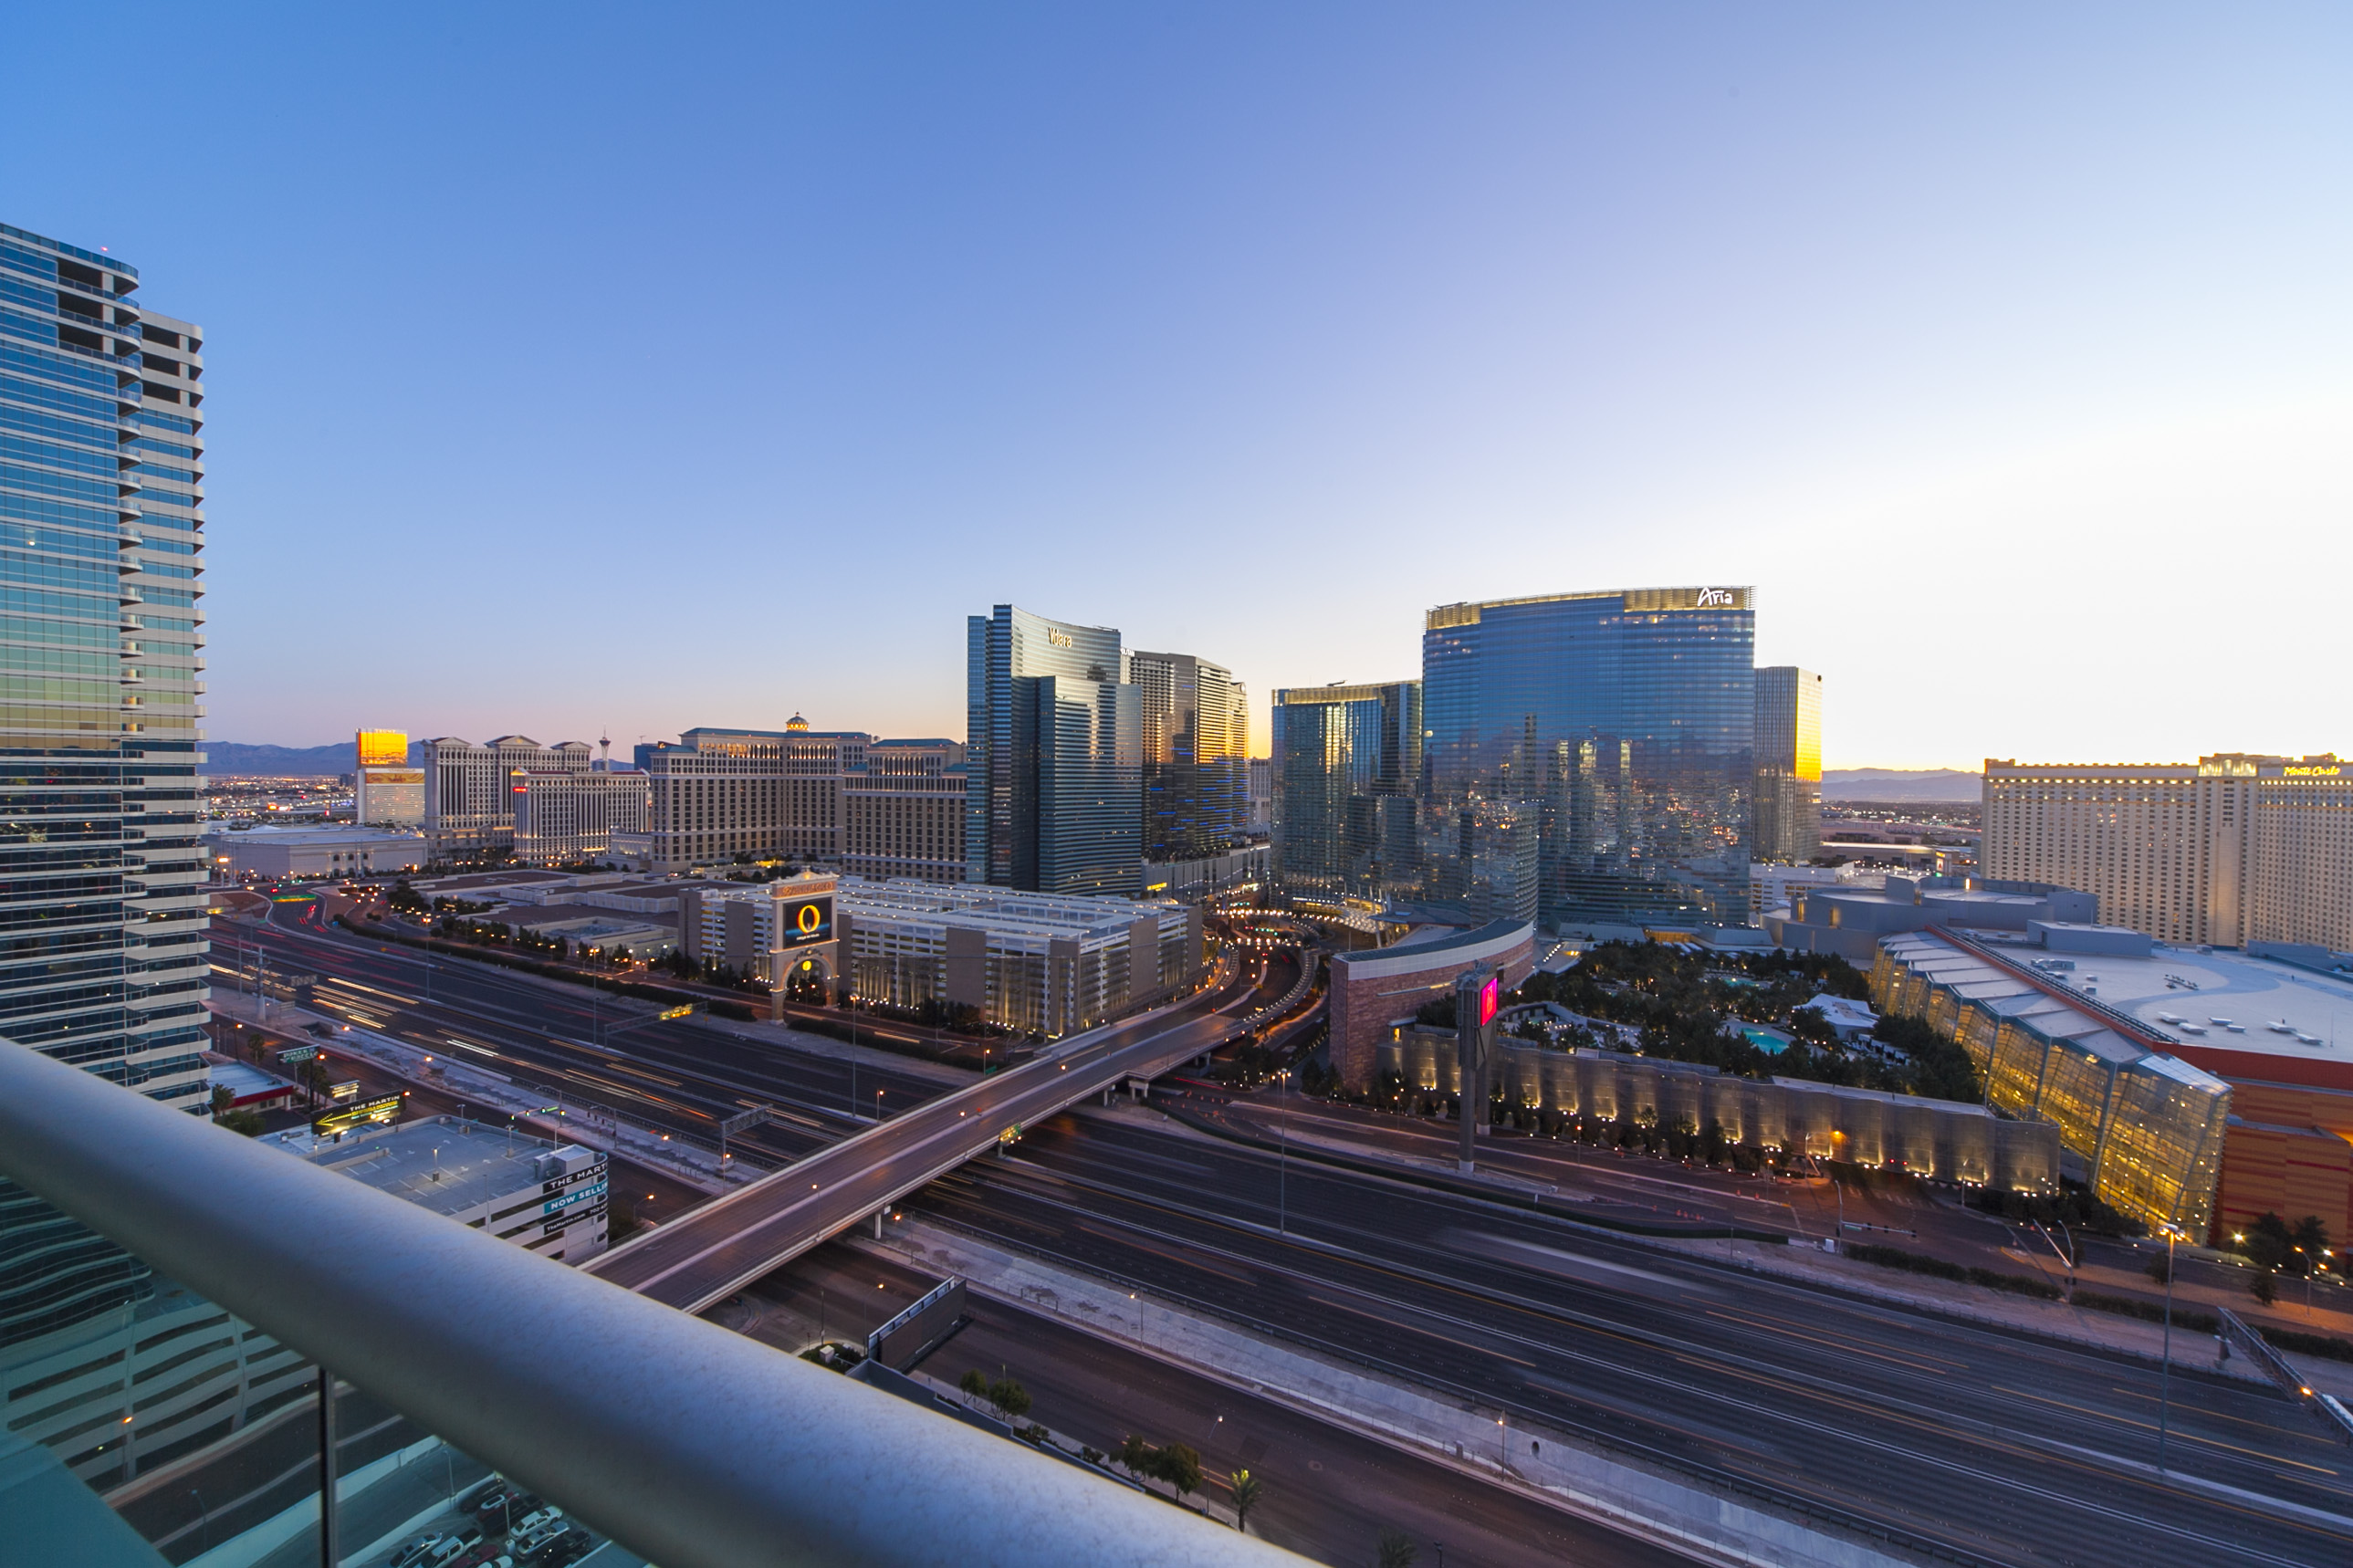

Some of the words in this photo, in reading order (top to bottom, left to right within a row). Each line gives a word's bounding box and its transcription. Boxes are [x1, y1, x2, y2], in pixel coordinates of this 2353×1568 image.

[1697, 586, 1733, 607] Aria
[1049, 627, 1072, 648] Vdara
[2283, 766, 2312, 777] Monte
[2312, 765, 2342, 777] Carlo
[797, 904, 821, 934] O
[350, 1103, 367, 1112] THE
[368, 1094, 401, 1107] MARTIN
[549, 1176, 573, 1189] THE
[550, 1195, 576, 1210] NOW
[547, 1213, 586, 1231] TheMartin.com
